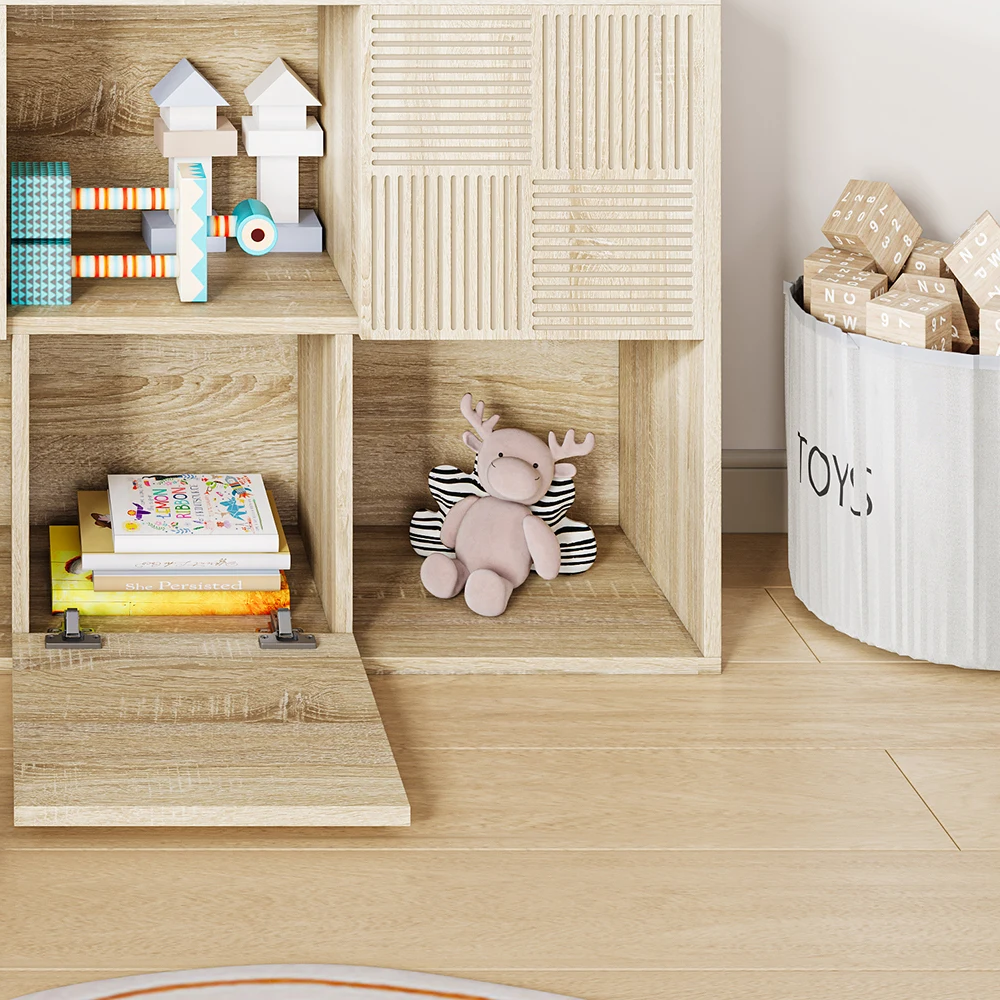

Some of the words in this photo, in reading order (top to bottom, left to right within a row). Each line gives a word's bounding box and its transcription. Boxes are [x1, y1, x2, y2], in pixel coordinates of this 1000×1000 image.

[881, 235, 891, 249] 3
[903, 234, 913, 247] 8
[842, 314, 858, 331] W
[880, 311, 890, 328] 9
[151, 487, 172, 519] LEMON
[170, 486, 192, 519] RIBBON
[125, 583, 153, 591] She
[158, 580, 244, 591] Persisted
